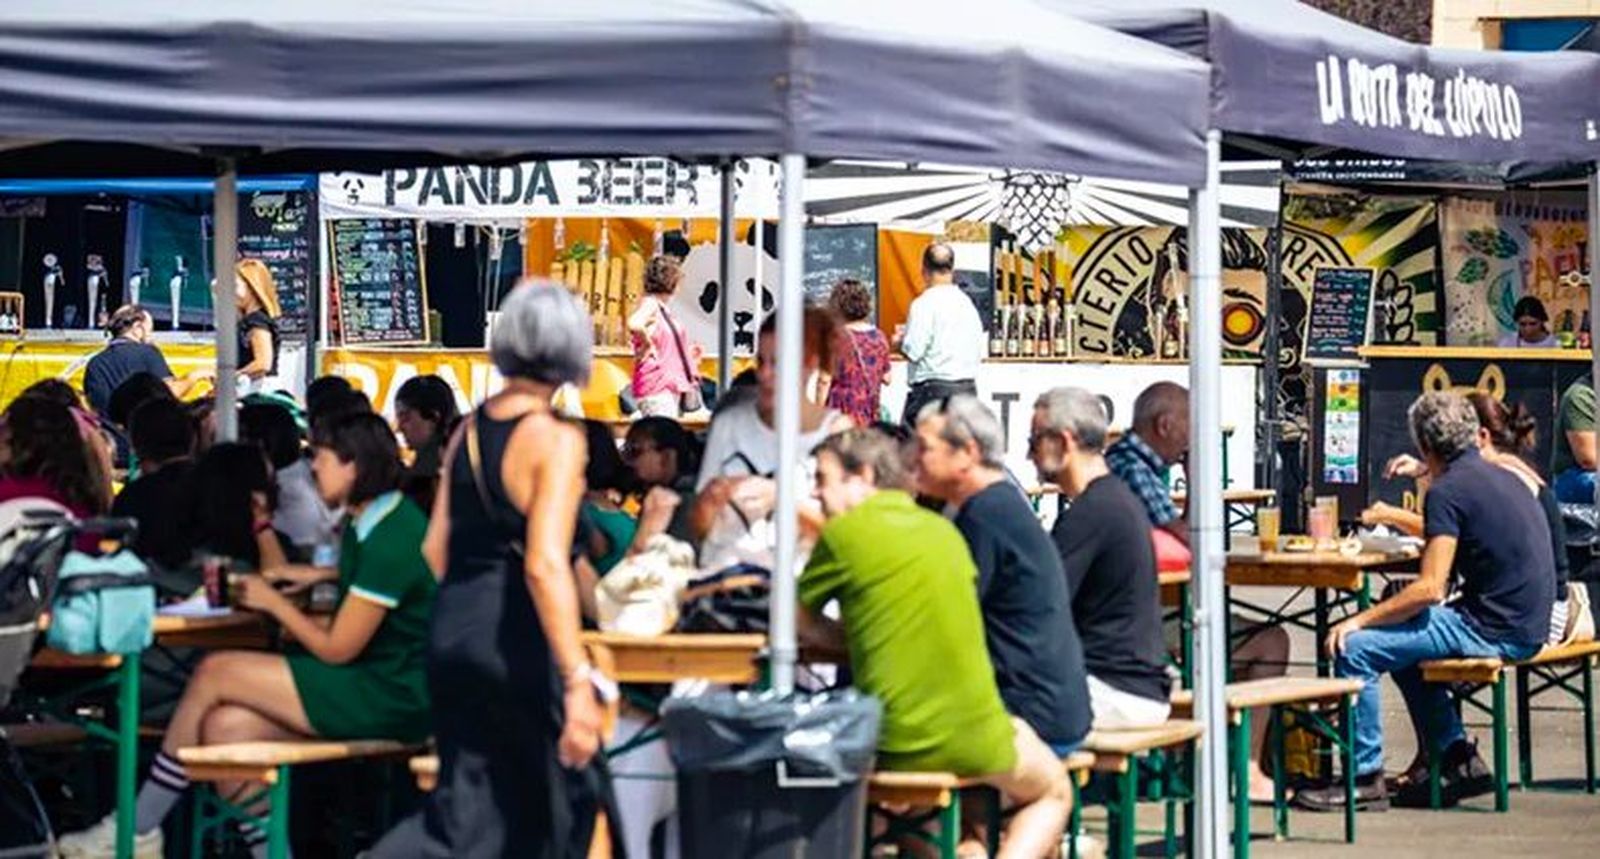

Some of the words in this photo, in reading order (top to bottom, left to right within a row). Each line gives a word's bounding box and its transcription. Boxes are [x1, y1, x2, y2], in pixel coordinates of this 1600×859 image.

[1316, 54, 1345, 125] LA
[1347, 57, 1402, 129] RUTA
[1406, 72, 1446, 136] DEL
[1444, 67, 1523, 141] LÚPULO
[382, 162, 560, 206] PANDA
[577, 158, 698, 205] BEER
[1078, 234, 1157, 355] CTERIO
